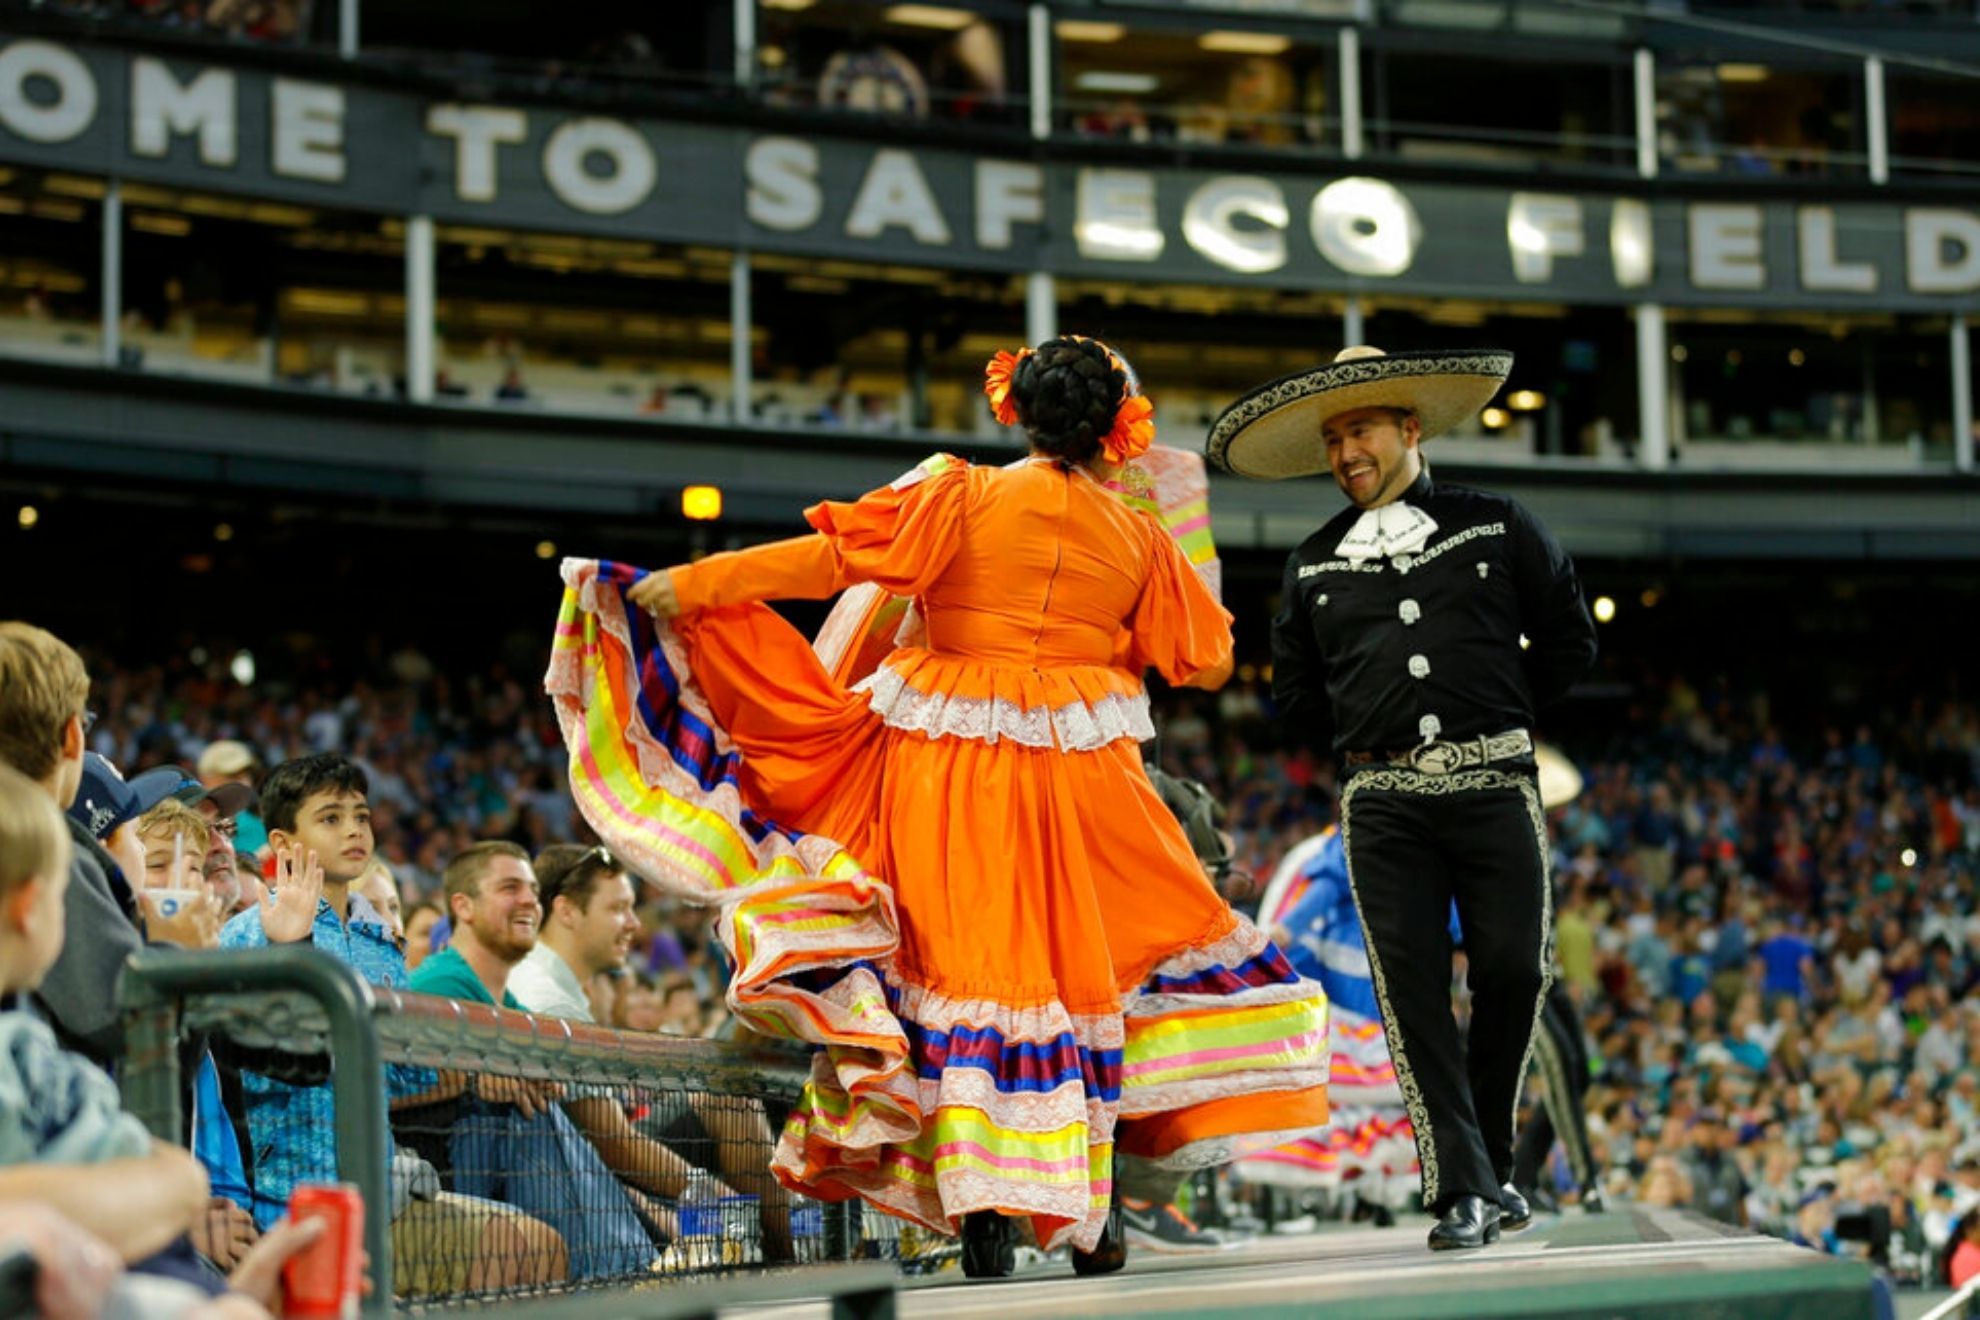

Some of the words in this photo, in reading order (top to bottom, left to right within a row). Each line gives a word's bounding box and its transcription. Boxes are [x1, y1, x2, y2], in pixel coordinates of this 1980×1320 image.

[427, 105, 658, 216] TO
[745, 136, 1420, 277] SAFECO
[1507, 193, 1980, 293] FIELD
